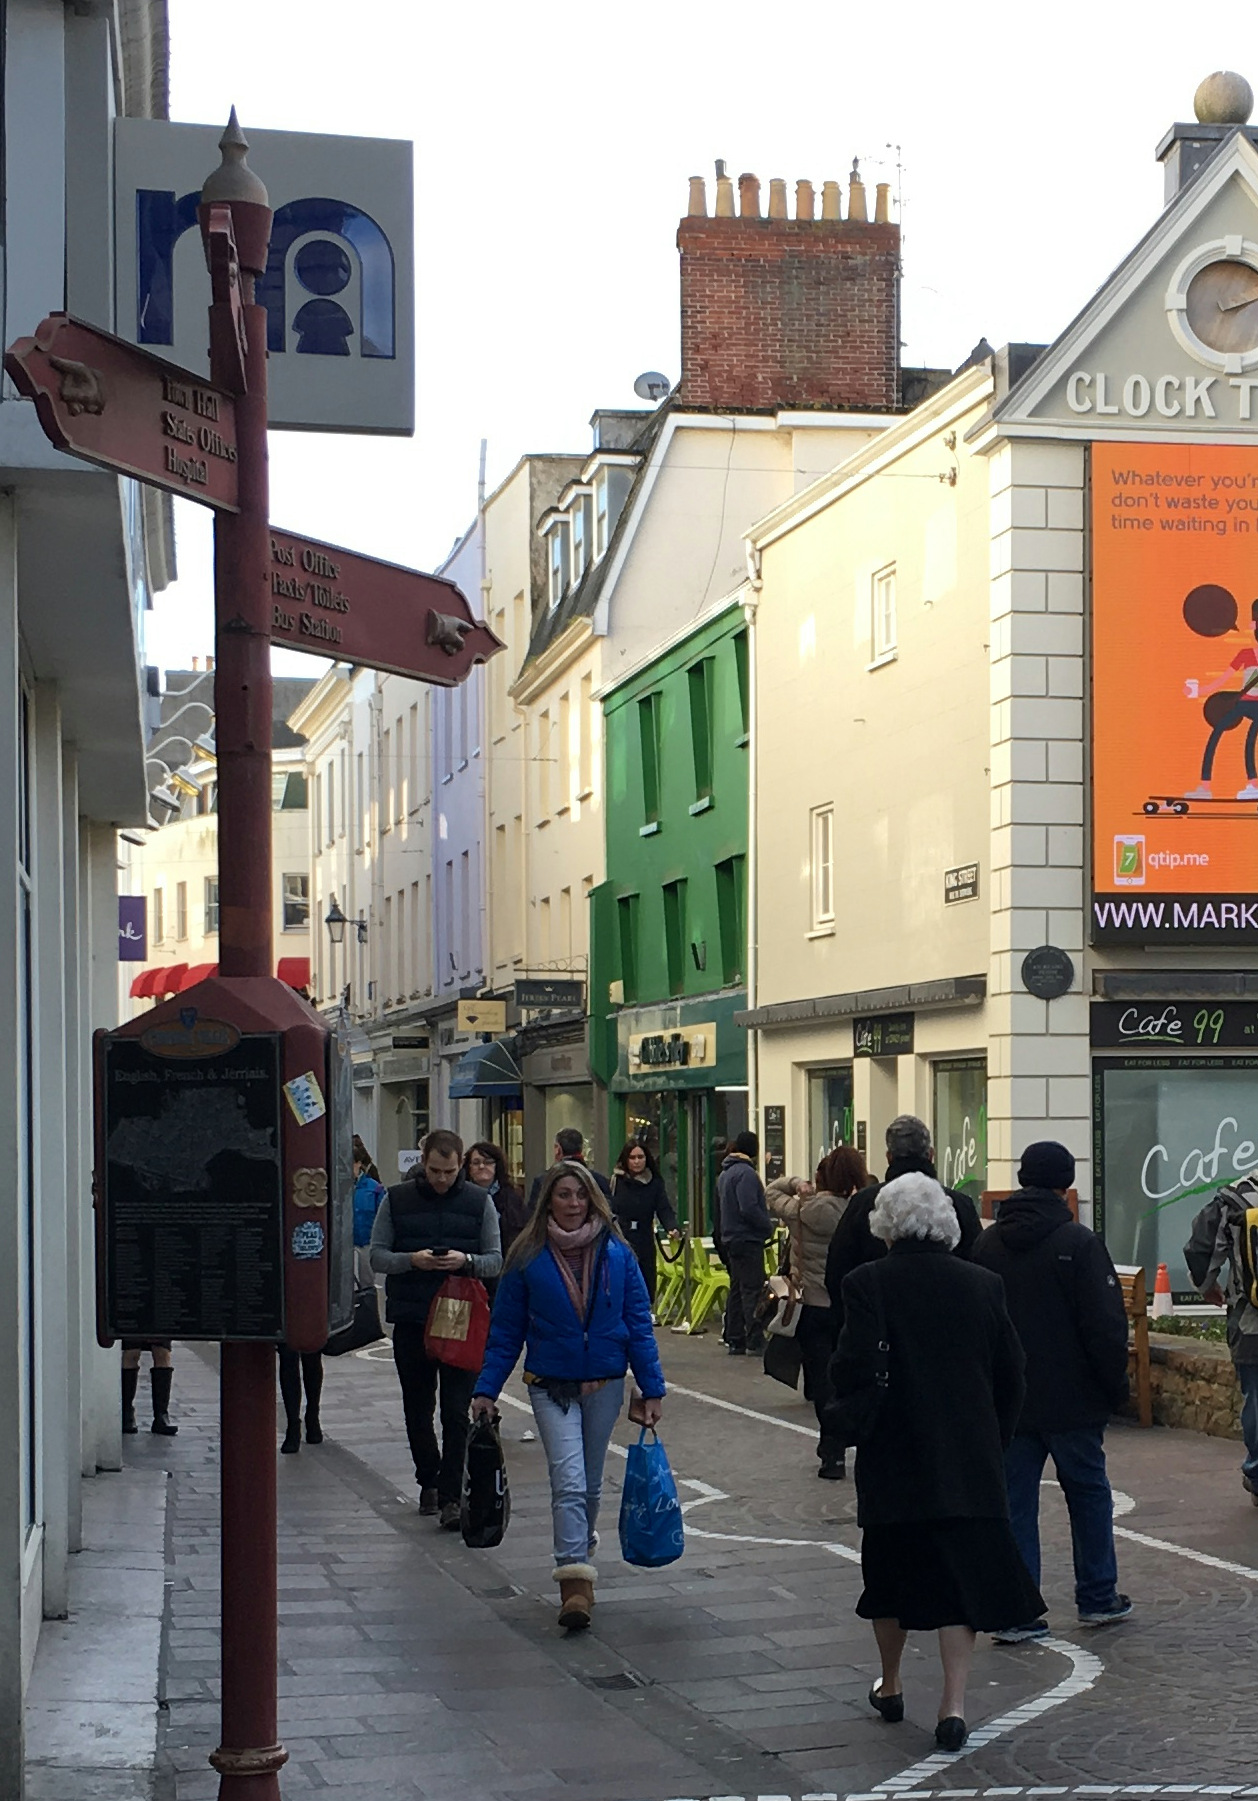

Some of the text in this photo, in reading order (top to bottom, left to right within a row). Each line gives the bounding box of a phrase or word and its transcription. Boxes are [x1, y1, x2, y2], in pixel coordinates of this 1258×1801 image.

[1066, 371, 1218, 418] CLOCK
[192, 389, 219, 423] Hall
[1111, 469, 1205, 488] Whatever
[1111, 492, 1160, 508] don't
[1165, 494, 1219, 510] waste
[1111, 514, 1154, 531] time
[1160, 515, 1227, 536] waiting
[1233, 517, 1250, 533] in
[270, 538, 341, 579] Post Office
[271, 604, 344, 644] Bus Station
[1125, 852, 1135, 866] 7
[1147, 850, 1209, 870] qtip.me
[1118, 1005, 1225, 1044] Cafe 99
[1243, 1025, 1255, 1034] at
